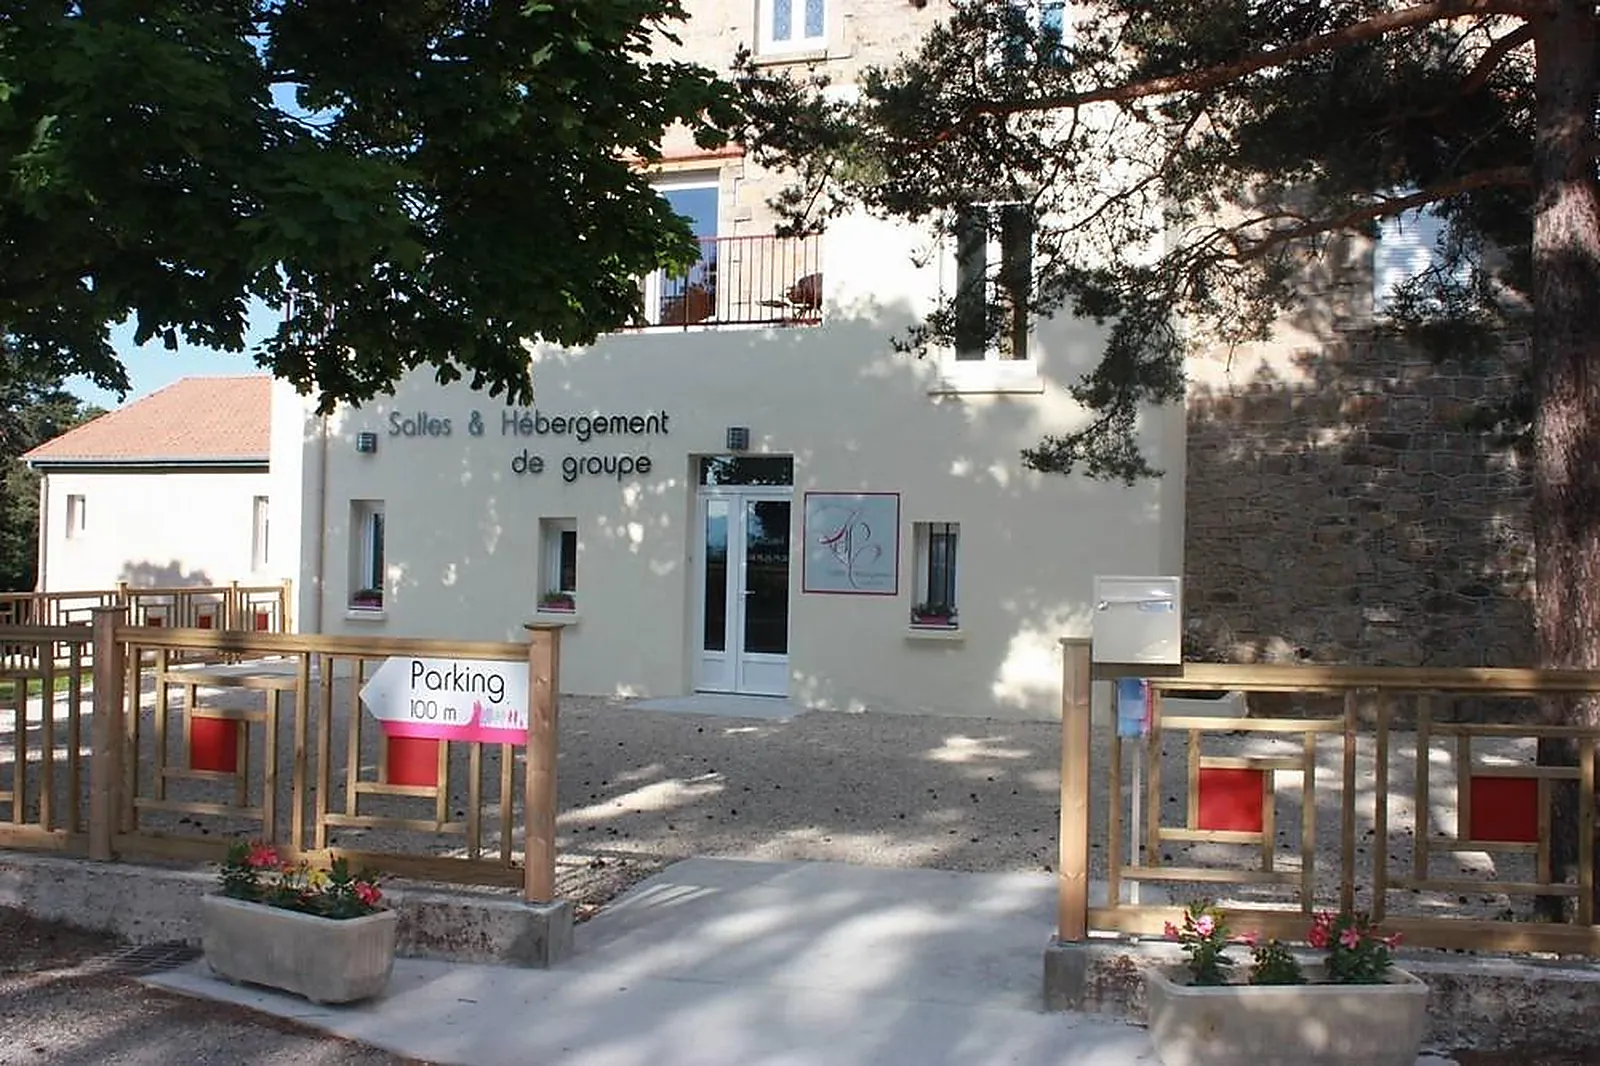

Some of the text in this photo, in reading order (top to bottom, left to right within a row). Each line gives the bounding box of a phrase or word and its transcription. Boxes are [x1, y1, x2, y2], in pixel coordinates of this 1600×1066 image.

[388, 409, 670, 442] Salles & Hébergement
[511, 449, 652, 482] de groupe
[411, 660, 505, 704] Parking
[410, 699, 457, 720] 100 m
